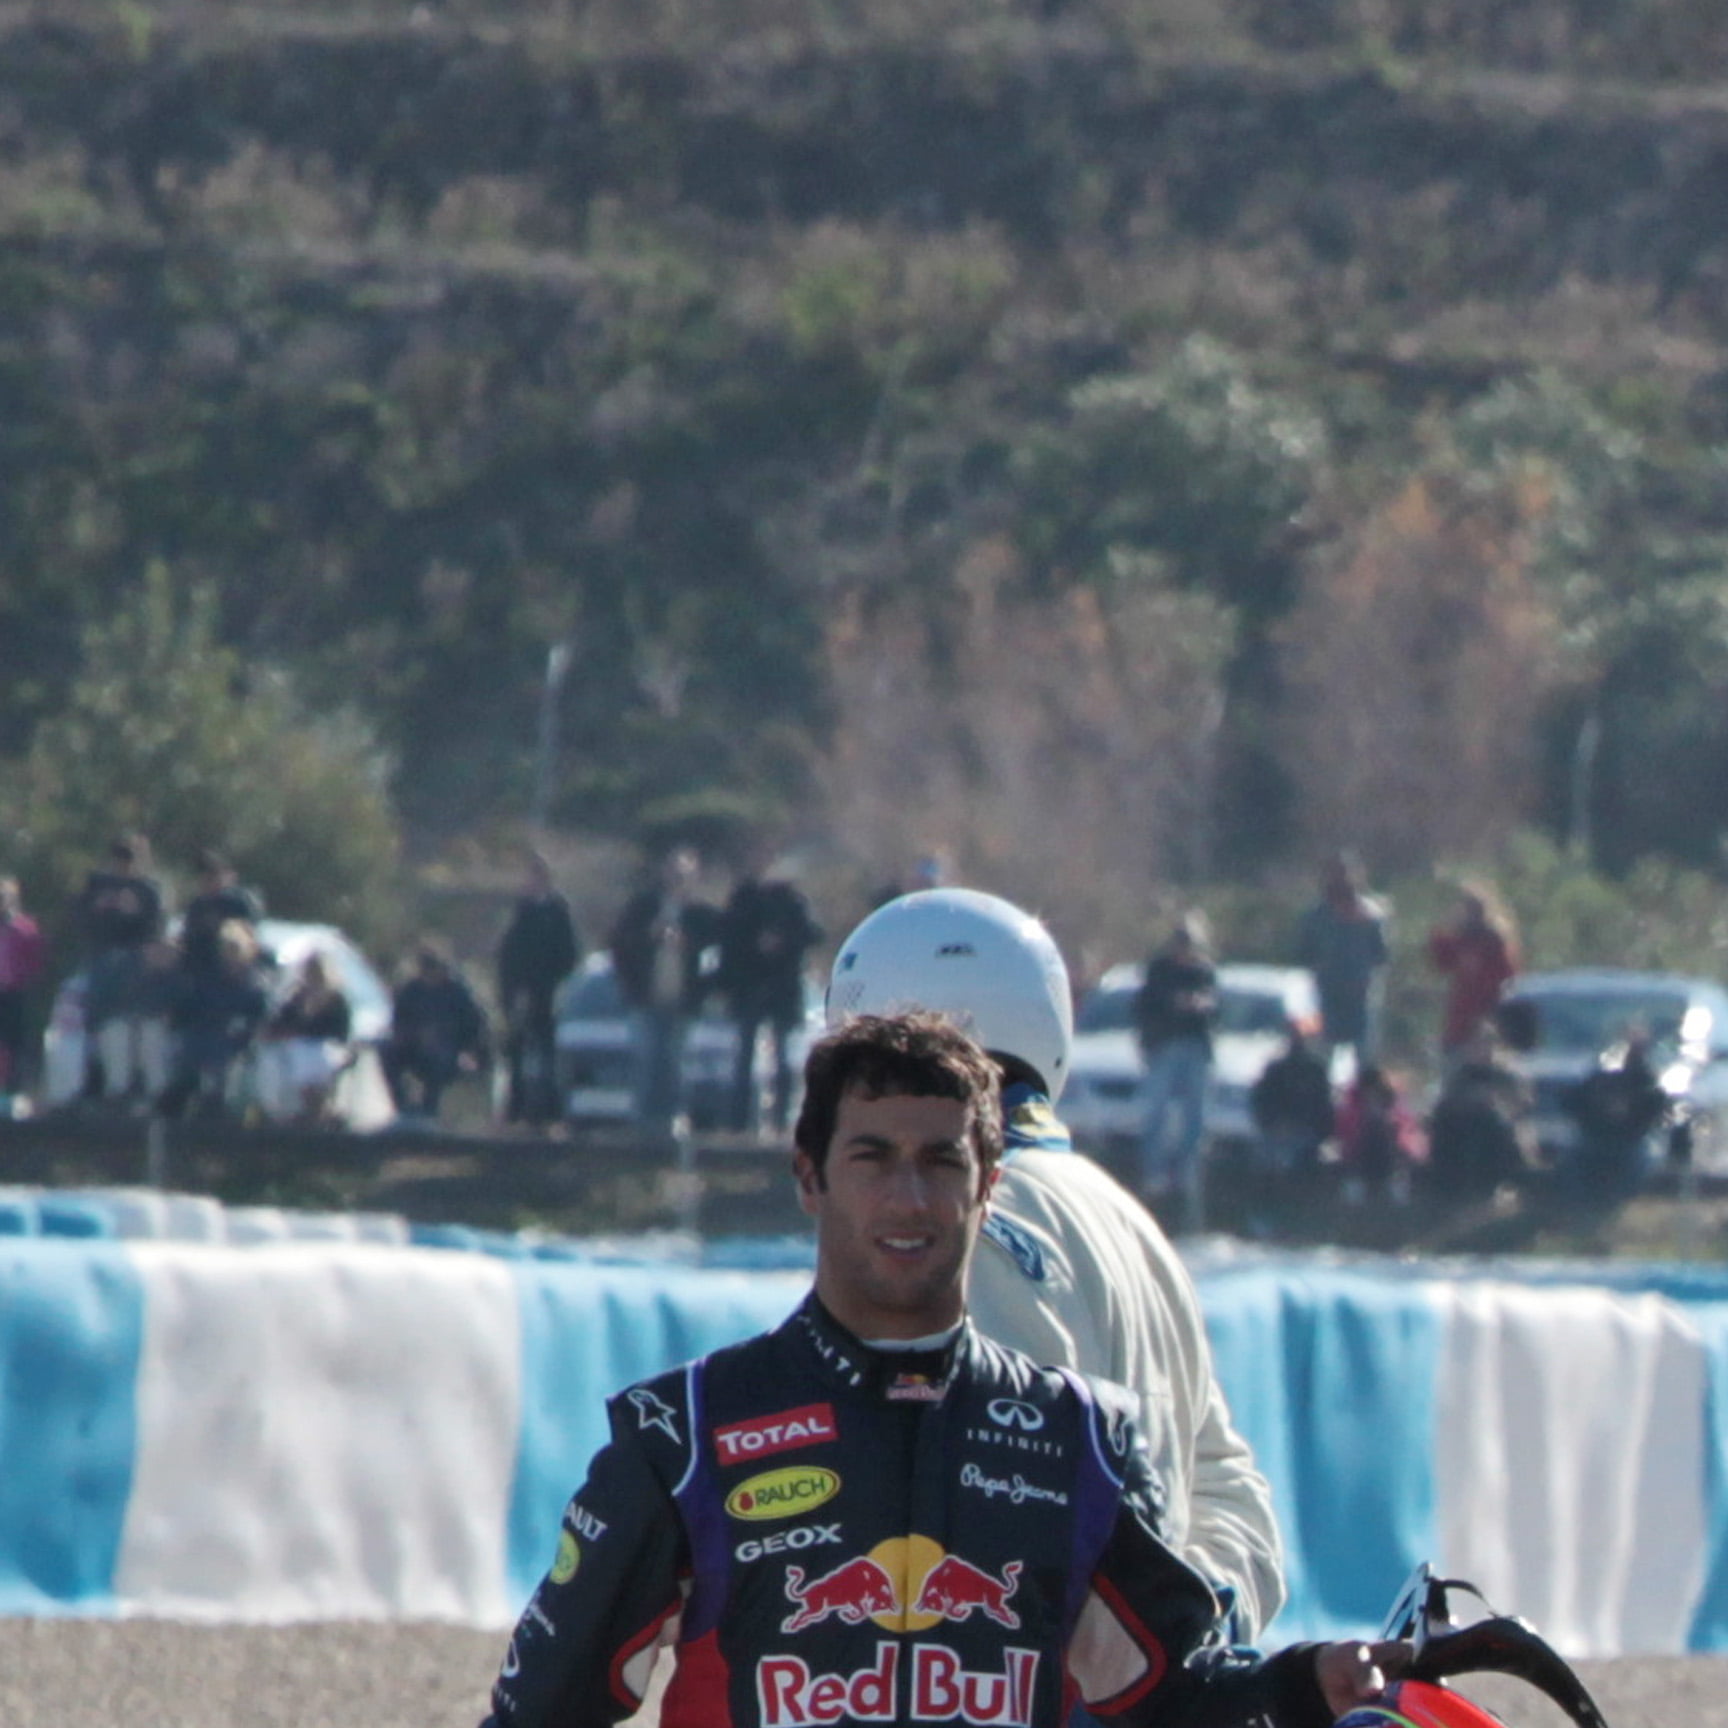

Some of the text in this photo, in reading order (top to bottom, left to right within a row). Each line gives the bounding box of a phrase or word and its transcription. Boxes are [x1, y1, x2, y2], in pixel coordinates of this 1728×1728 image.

[717, 1417, 831, 1454] TOTAL
[966, 1428, 1063, 1458] INFINITI
[754, 1476, 826, 1506] RAUCH
[960, 1463, 1068, 1505] Pepe Jeans
[735, 1523, 842, 1562] GEOX
